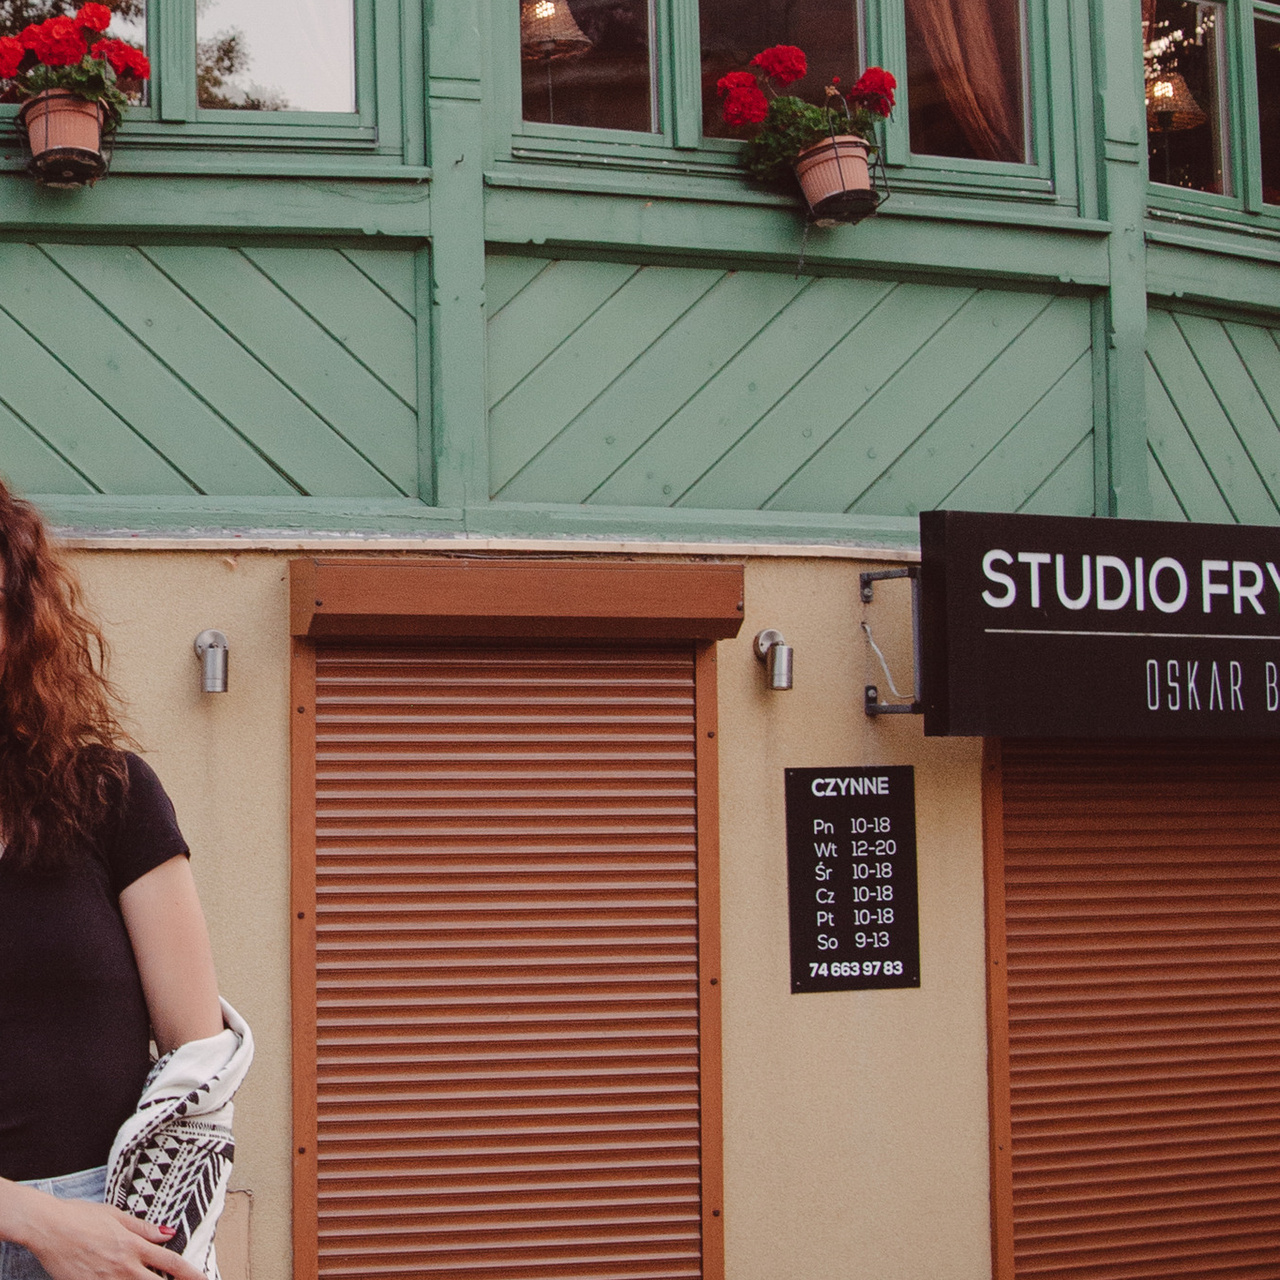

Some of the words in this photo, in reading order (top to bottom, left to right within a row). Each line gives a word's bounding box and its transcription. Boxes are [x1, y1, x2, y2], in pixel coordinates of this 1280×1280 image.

[981, 548, 1188, 614] STUDIO
[1146, 659, 1244, 711] OSKAR
[811, 776, 890, 797] CZYNNE
[813, 819, 834, 835] Pn
[850, 816, 891, 834] 10-18
[813, 842, 838, 858] Wt
[851, 839, 897, 857] 12-20
[815, 861, 833, 881] Śr
[852, 862, 893, 880] 10-18
[815, 887, 836, 904] Cz
[852, 885, 894, 903] 10-18
[816, 910, 835, 927] Pt
[853, 907, 895, 926] 10-18
[817, 933, 839, 951] So
[854, 931, 890, 949] 9-13
[809, 962, 829, 978] 74
[830, 961, 860, 977] 663
[862, 960, 882, 976] 97
[883, 960, 904, 976] 83
